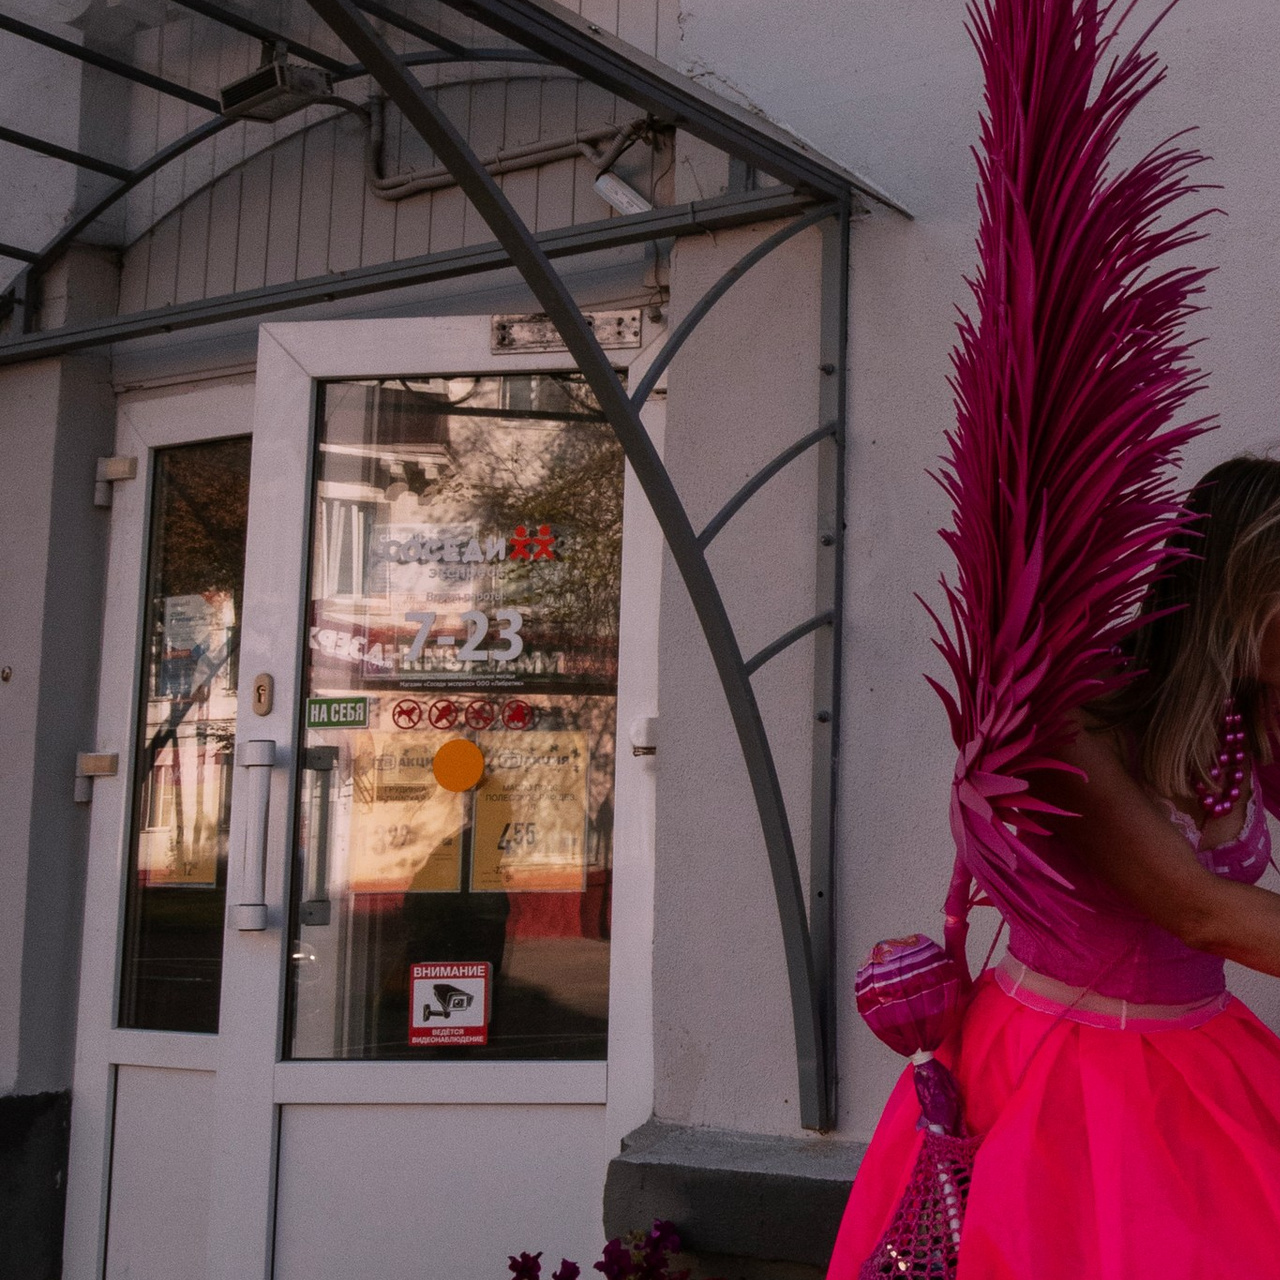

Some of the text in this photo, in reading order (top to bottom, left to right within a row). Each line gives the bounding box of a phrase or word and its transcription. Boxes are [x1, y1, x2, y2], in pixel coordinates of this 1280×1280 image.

[404, 610, 524, 663] 7-23
[310, 701, 365, 723] НА СЕБЯ
[413, 965, 486, 978] ВНИМАНИЕ
[411, 1035, 484, 1045] ВИДЕОНАБЛЮДЕНИЕ
